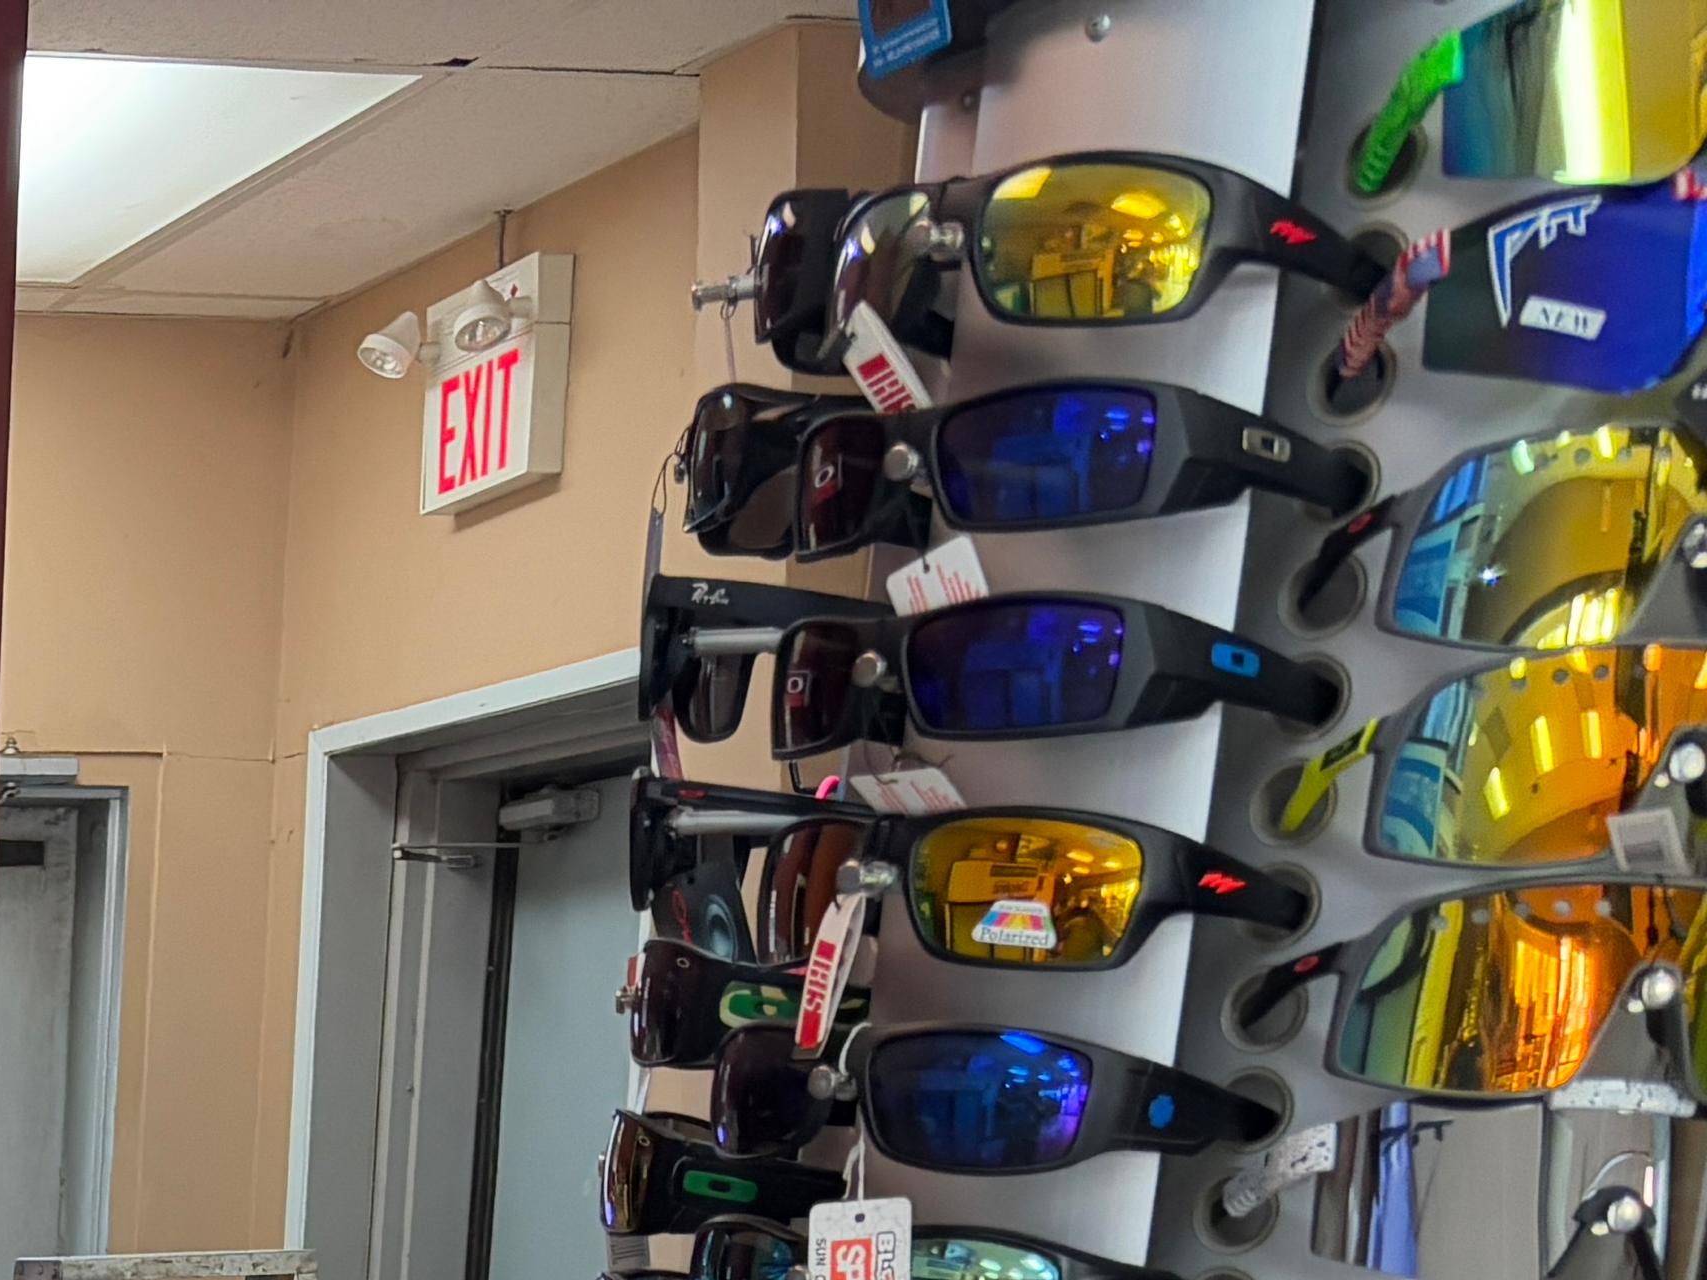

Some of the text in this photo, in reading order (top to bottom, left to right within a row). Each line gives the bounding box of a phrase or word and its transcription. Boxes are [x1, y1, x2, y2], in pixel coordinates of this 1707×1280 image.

[1538, 305, 1593, 336] NEW
[438, 348, 519, 495] EXIT
[980, 927, 1050, 946] Polarized
[804, 957, 833, 1014] IRIS
[816, 1238, 826, 1266] SUN
